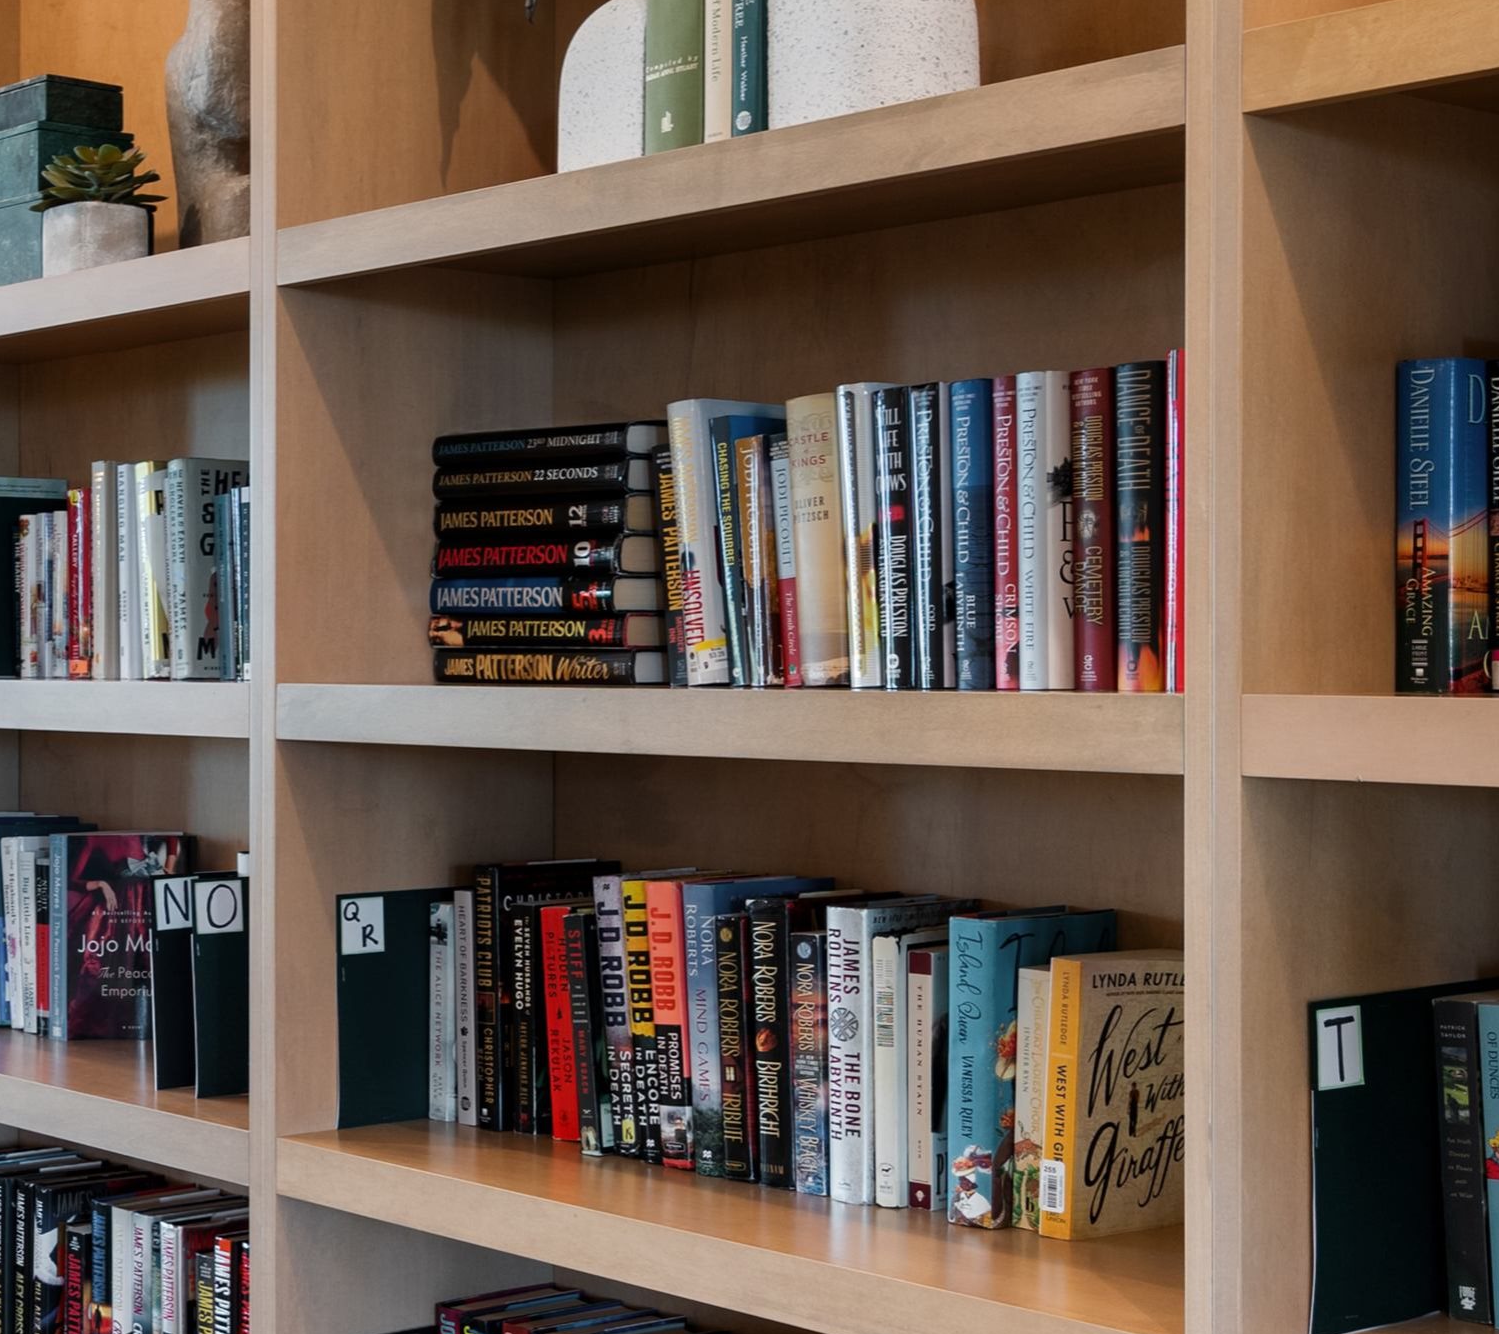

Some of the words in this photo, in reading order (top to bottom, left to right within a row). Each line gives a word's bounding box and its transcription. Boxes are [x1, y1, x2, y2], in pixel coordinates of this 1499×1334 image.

[438, 474, 471, 486] JAMES
[473, 472, 533, 484] PATTERSON
[546, 467, 598, 479] SECONDS
[437, 589, 481, 612] JAMES
[483, 588, 562, 607] PATTERSON
[956, 572, 964, 652] LABYRINTH
[966, 594, 976, 629] BLUE
[445, 660, 473, 676] JAMES
[476, 655, 553, 680] PATTERSON
[556, 656, 611, 680] Writer
[163, 880, 190, 924] N
[343, 902, 361, 922] Q
[78, 935, 119, 956] Jojo
[362, 924, 378, 946] R
[514, 919, 523, 964] EVELYN
[752, 921, 777, 960] NORA
[568, 930, 581, 980] STIFF
[515, 971, 523, 1010] HUGO
[754, 964, 777, 1023] ROBERTS
[1092, 972, 1137, 988] LYNDA
[668, 1032, 681, 1100] PROMISES
[845, 1053, 859, 1084] THE
[1323, 1016, 1355, 1083] T
[755, 1058, 781, 1138] BIRTHRIGHT
[830, 1046, 842, 1140] LABYRINTH
[845, 1089, 860, 1138] BONE
